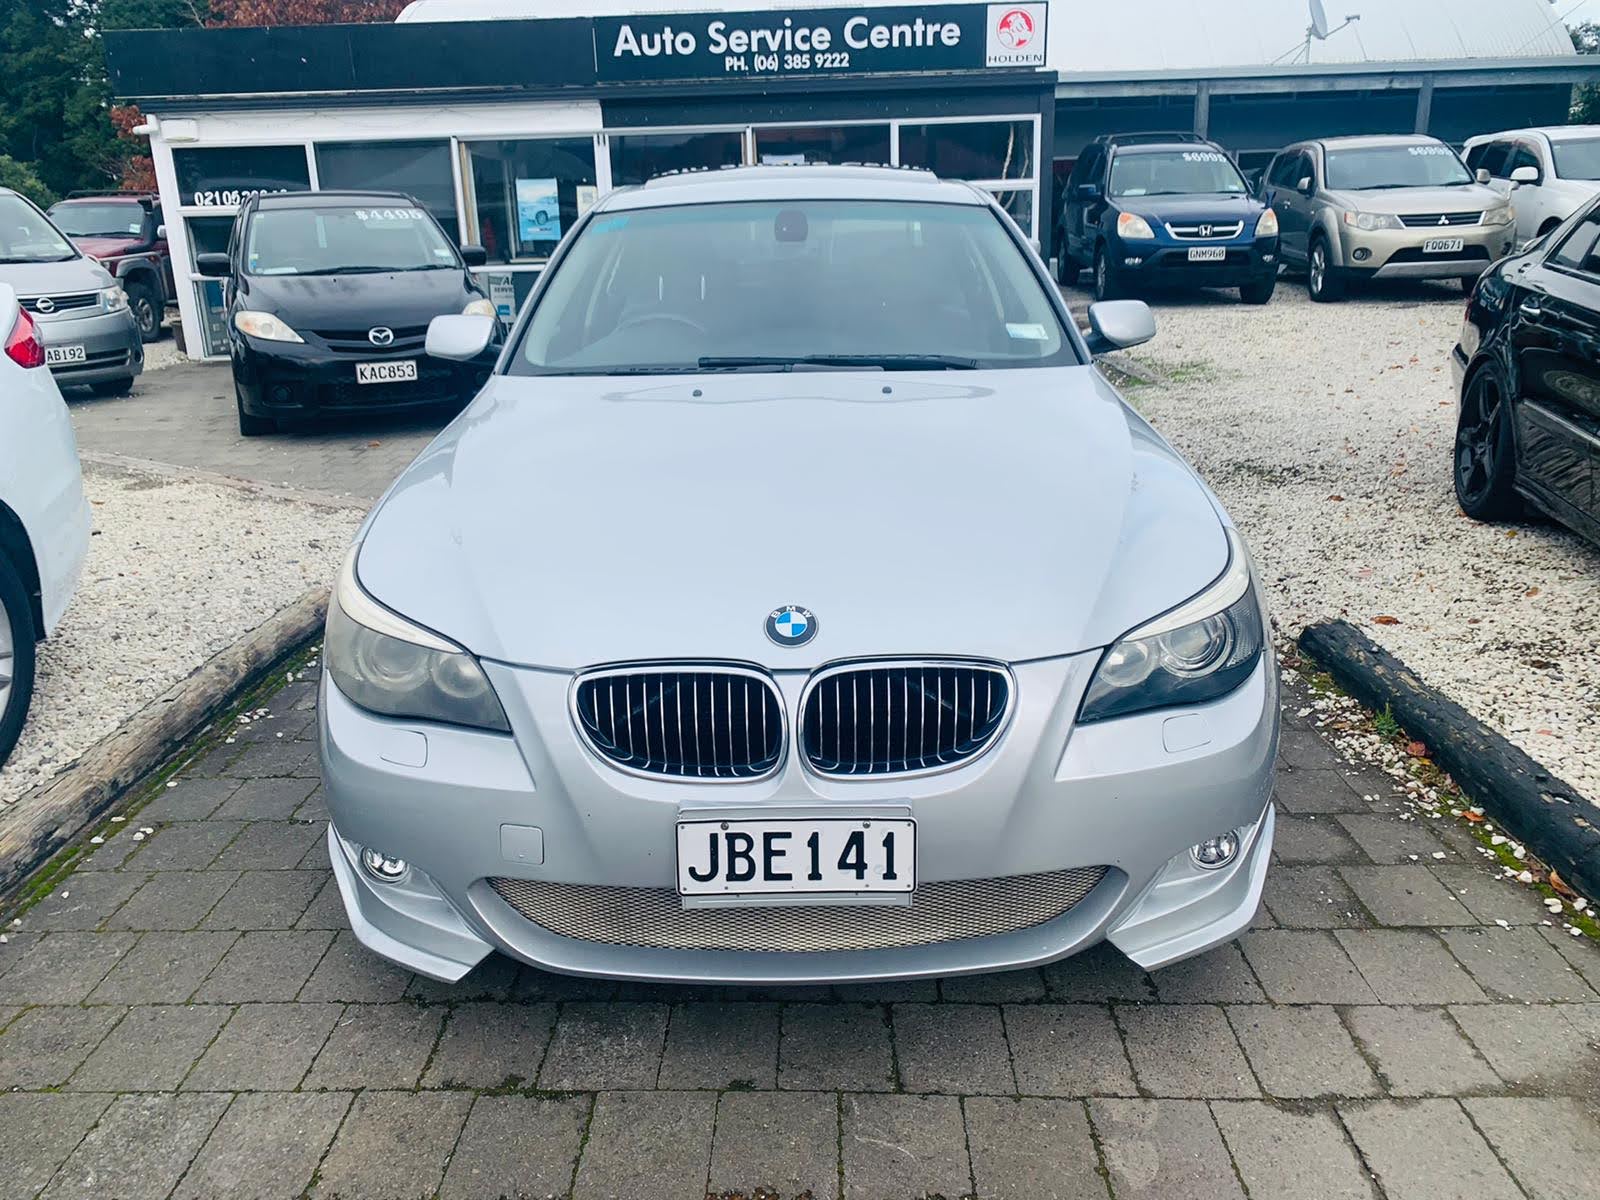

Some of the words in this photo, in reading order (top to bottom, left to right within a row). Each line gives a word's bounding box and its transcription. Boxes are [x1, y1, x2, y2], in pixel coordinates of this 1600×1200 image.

[613, 24, 697, 57] Auto
[707, 17, 832, 54] Service
[843, 16, 961, 49] Centre
[725, 55, 749, 72] PH.
[754, 53, 779, 72] (06)
[783, 54, 811, 70] 385
[814, 52, 850, 69] 9222
[988, 54, 1043, 64] HOLDEN
[359, 363, 416, 381] KAC853
[770, 605, 813, 619] BMW
[688, 830, 898, 882] JBE141
